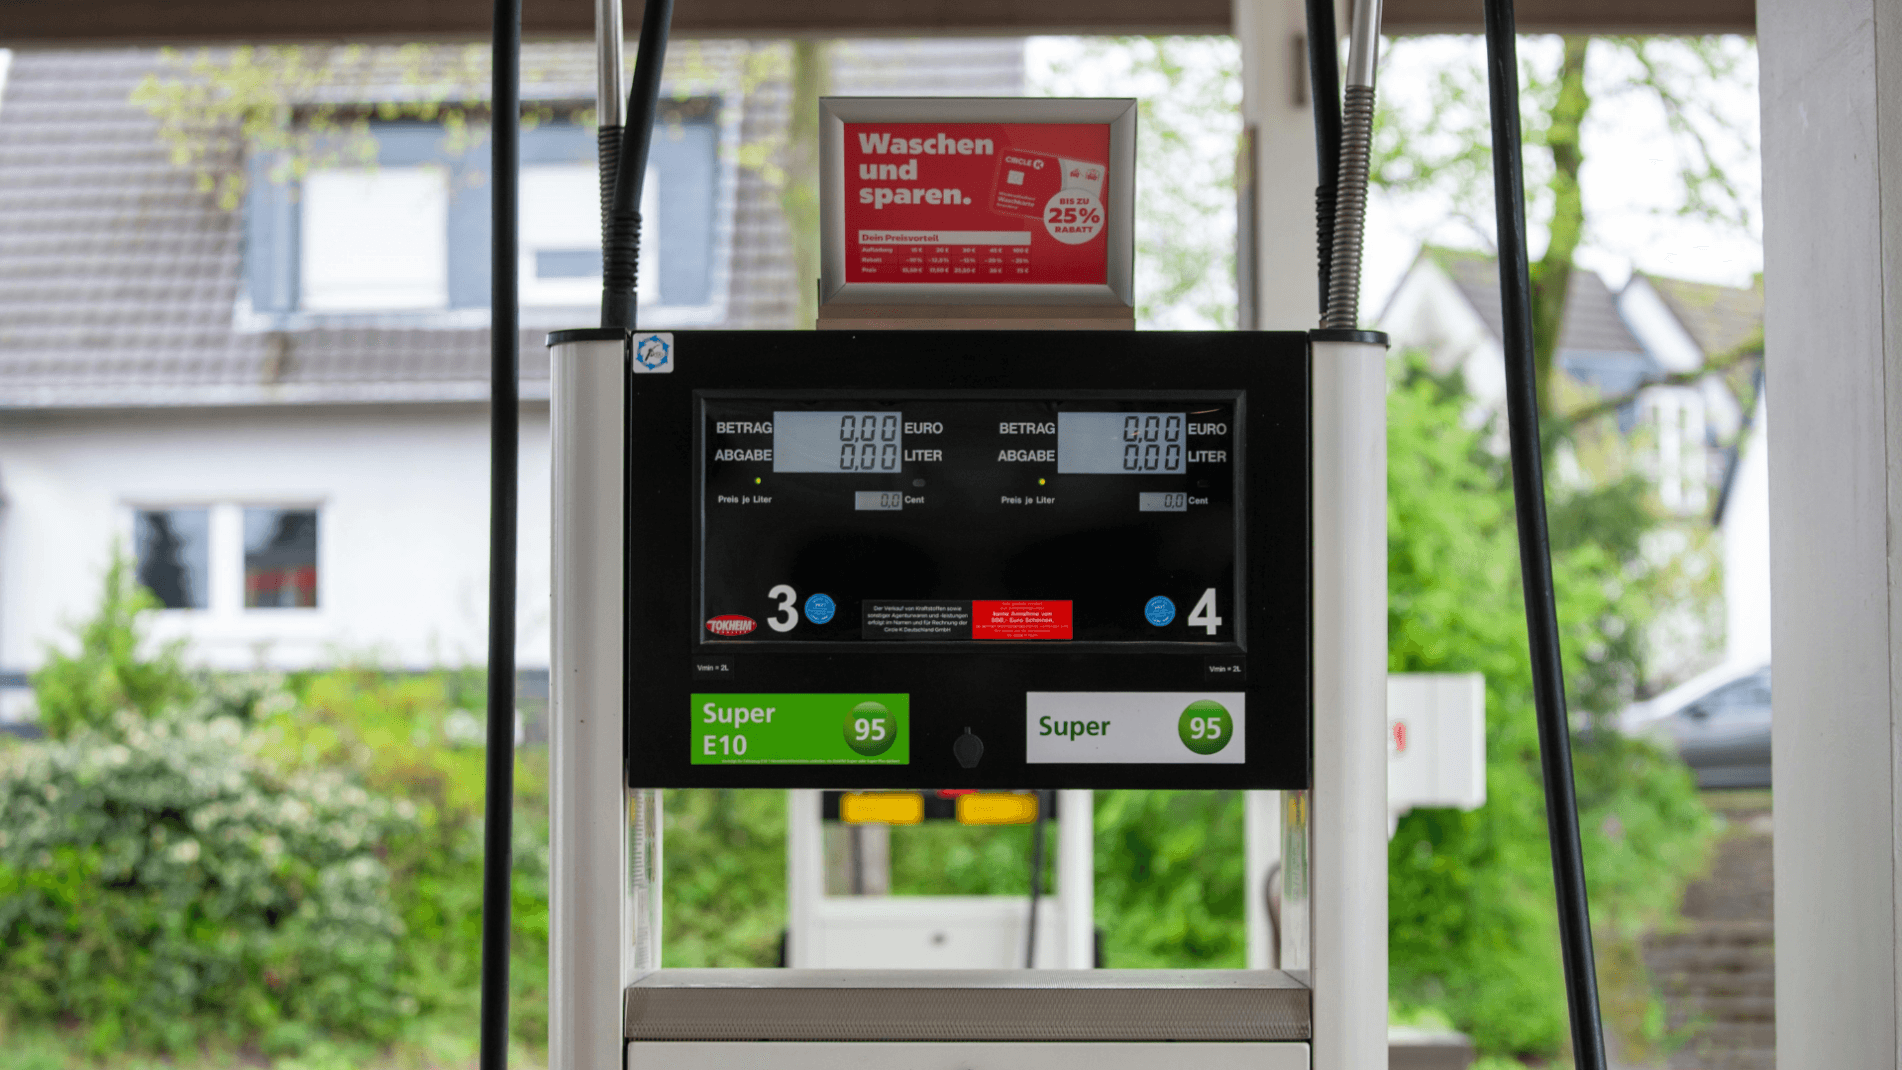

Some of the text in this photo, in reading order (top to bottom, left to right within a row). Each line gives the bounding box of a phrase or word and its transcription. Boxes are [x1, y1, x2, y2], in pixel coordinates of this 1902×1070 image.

[858, 132, 994, 155] Waschen
[1004, 156, 1032, 167] CIRCLE
[859, 159, 918, 180] und
[859, 187, 972, 209] sparen.
[1059, 198, 1090, 206] BIS ZU
[1048, 207, 1100, 224] 25%
[862, 234, 939, 242] Dein Preisvorteil
[716, 422, 773, 434] BETRAG
[840, 415, 897, 443] 0,00
[904, 422, 944, 434] EURO
[999, 422, 1056, 434] BETRAG
[1123, 416, 1181, 443] 0,00
[1188, 423, 1227, 435] EURO
[714, 449, 772, 461] ABGABE
[840, 444, 897, 471] 0,00
[904, 450, 943, 461] LITER
[998, 450, 1056, 462] ABGABE
[1123, 444, 1181, 471] 0,00
[1188, 451, 1227, 463] LITER
[718, 495, 772, 505] Preis je Liter
[880, 494, 900, 508] 0,0
[1001, 496, 1055, 505] Preis je Liter
[1164, 494, 1184, 509] 0,0
[767, 584, 799, 632] 3
[1187, 588, 1222, 635] 4
[706, 619, 752, 632] TOKHEIM
[703, 702, 776, 729] Super
[854, 718, 886, 741] 95
[1039, 716, 1110, 741] Super
[1190, 717, 1221, 739] 95
[703, 735, 747, 755] E10
